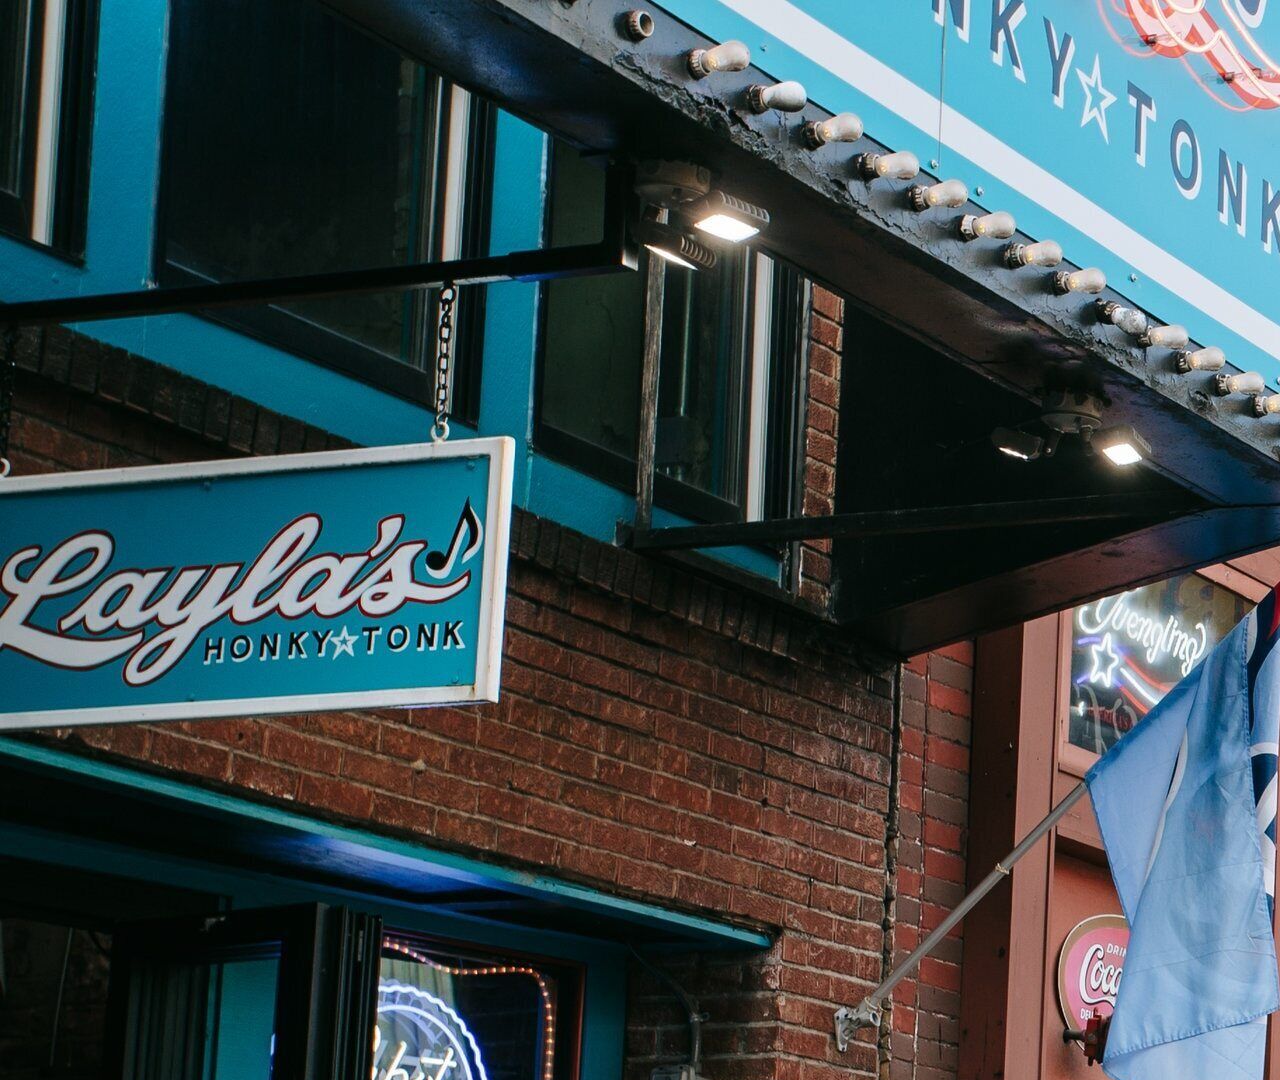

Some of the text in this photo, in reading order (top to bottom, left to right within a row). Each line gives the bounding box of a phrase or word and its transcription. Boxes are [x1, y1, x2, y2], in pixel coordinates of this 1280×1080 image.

[0, 511, 470, 687] Layla's
[204, 619, 466, 665] HONKY TONK
